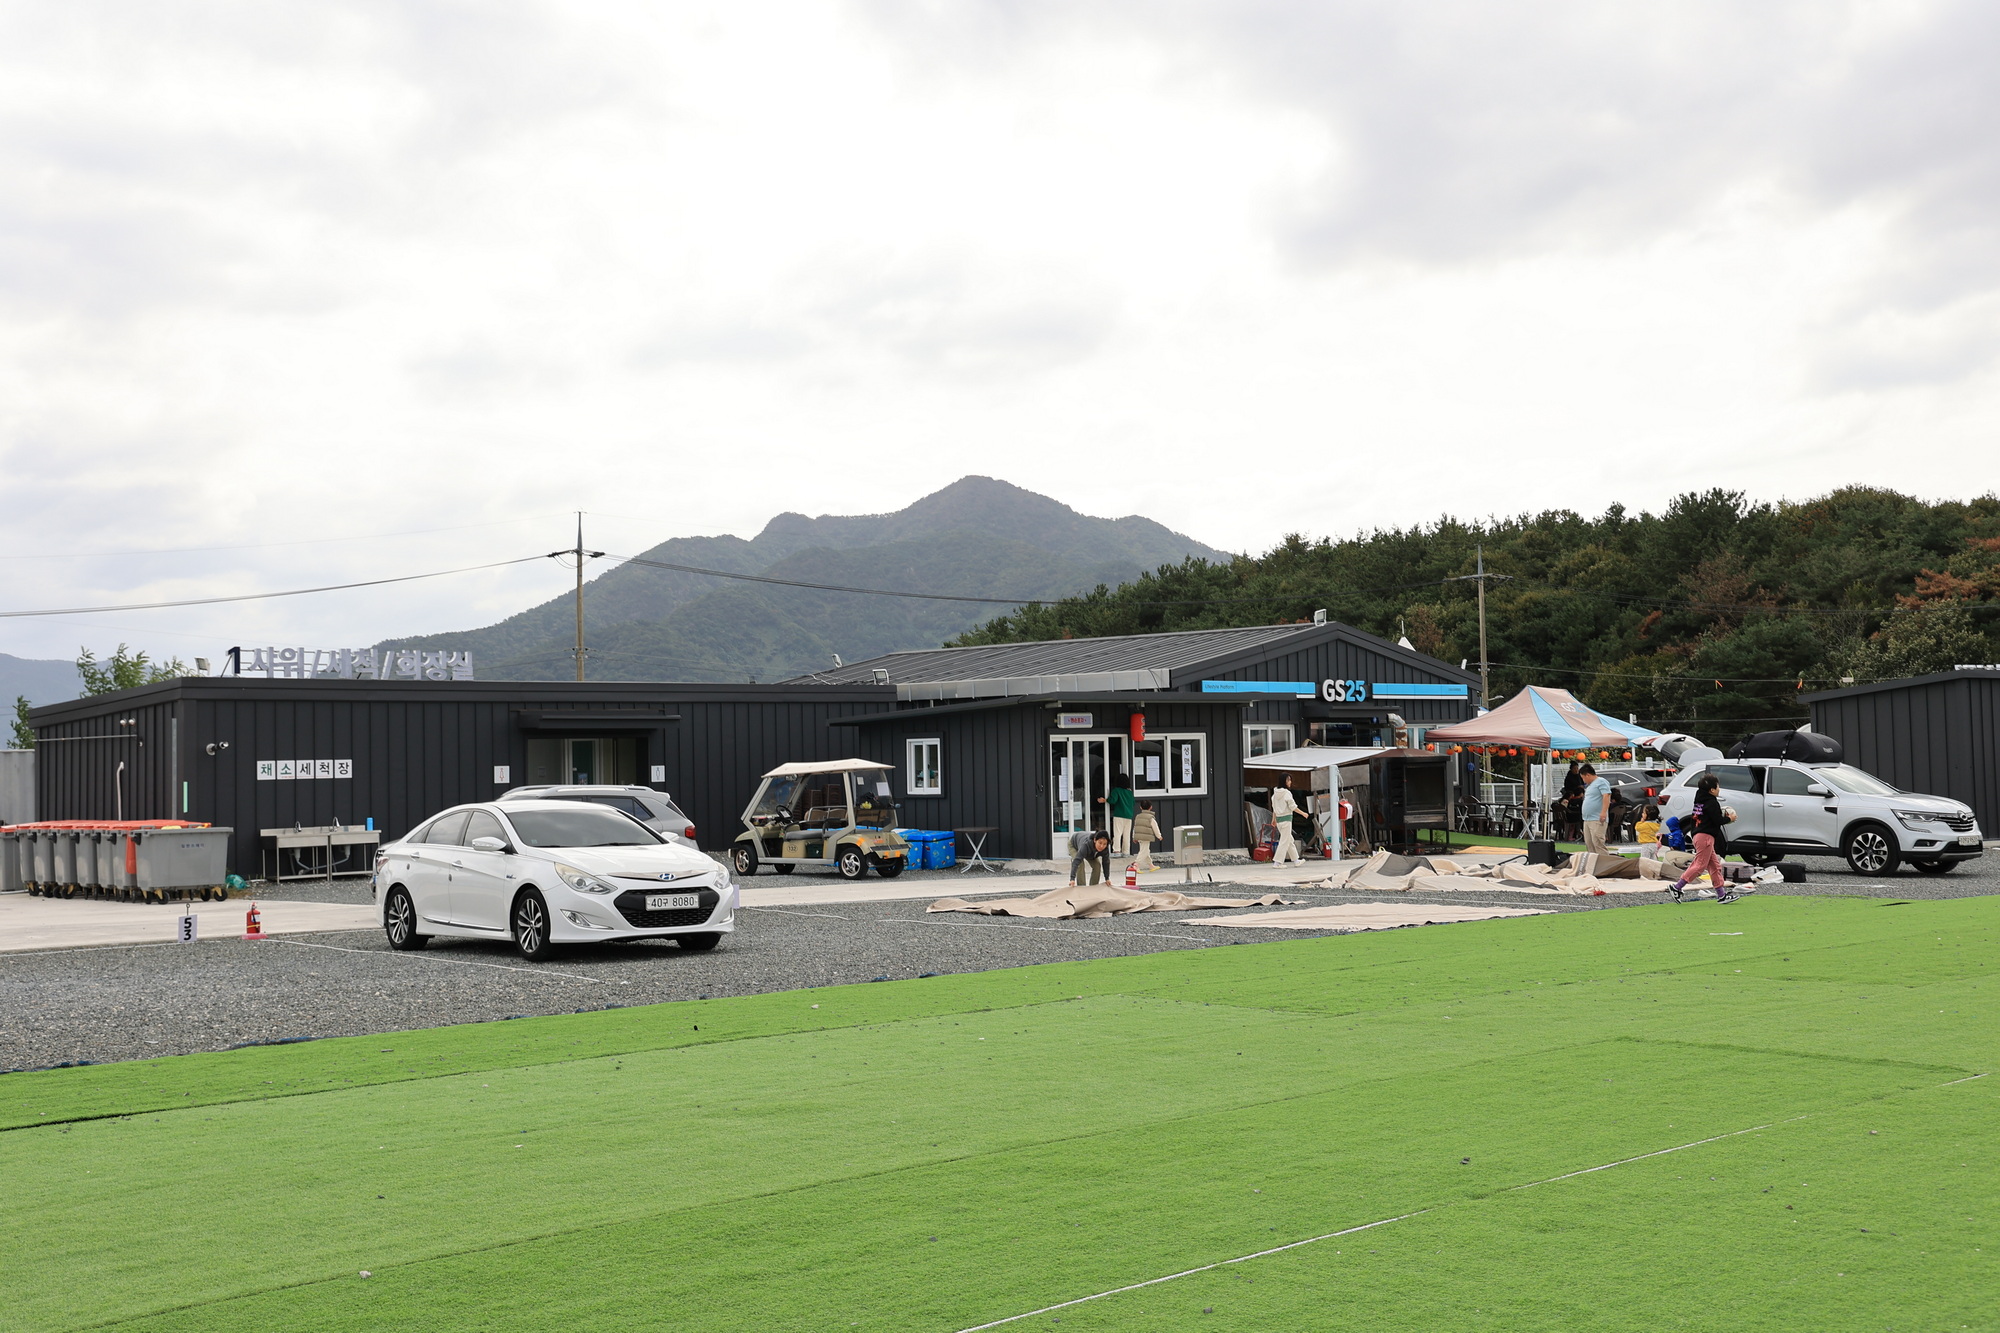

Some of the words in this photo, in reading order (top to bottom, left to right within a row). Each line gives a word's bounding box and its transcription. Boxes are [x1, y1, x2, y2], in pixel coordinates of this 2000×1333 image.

[1322, 679, 1366, 702] GS25
[260, 762, 350, 777] 채소세척장
[672, 896, 695, 907] 8080
[183, 917, 192, 941] 53
